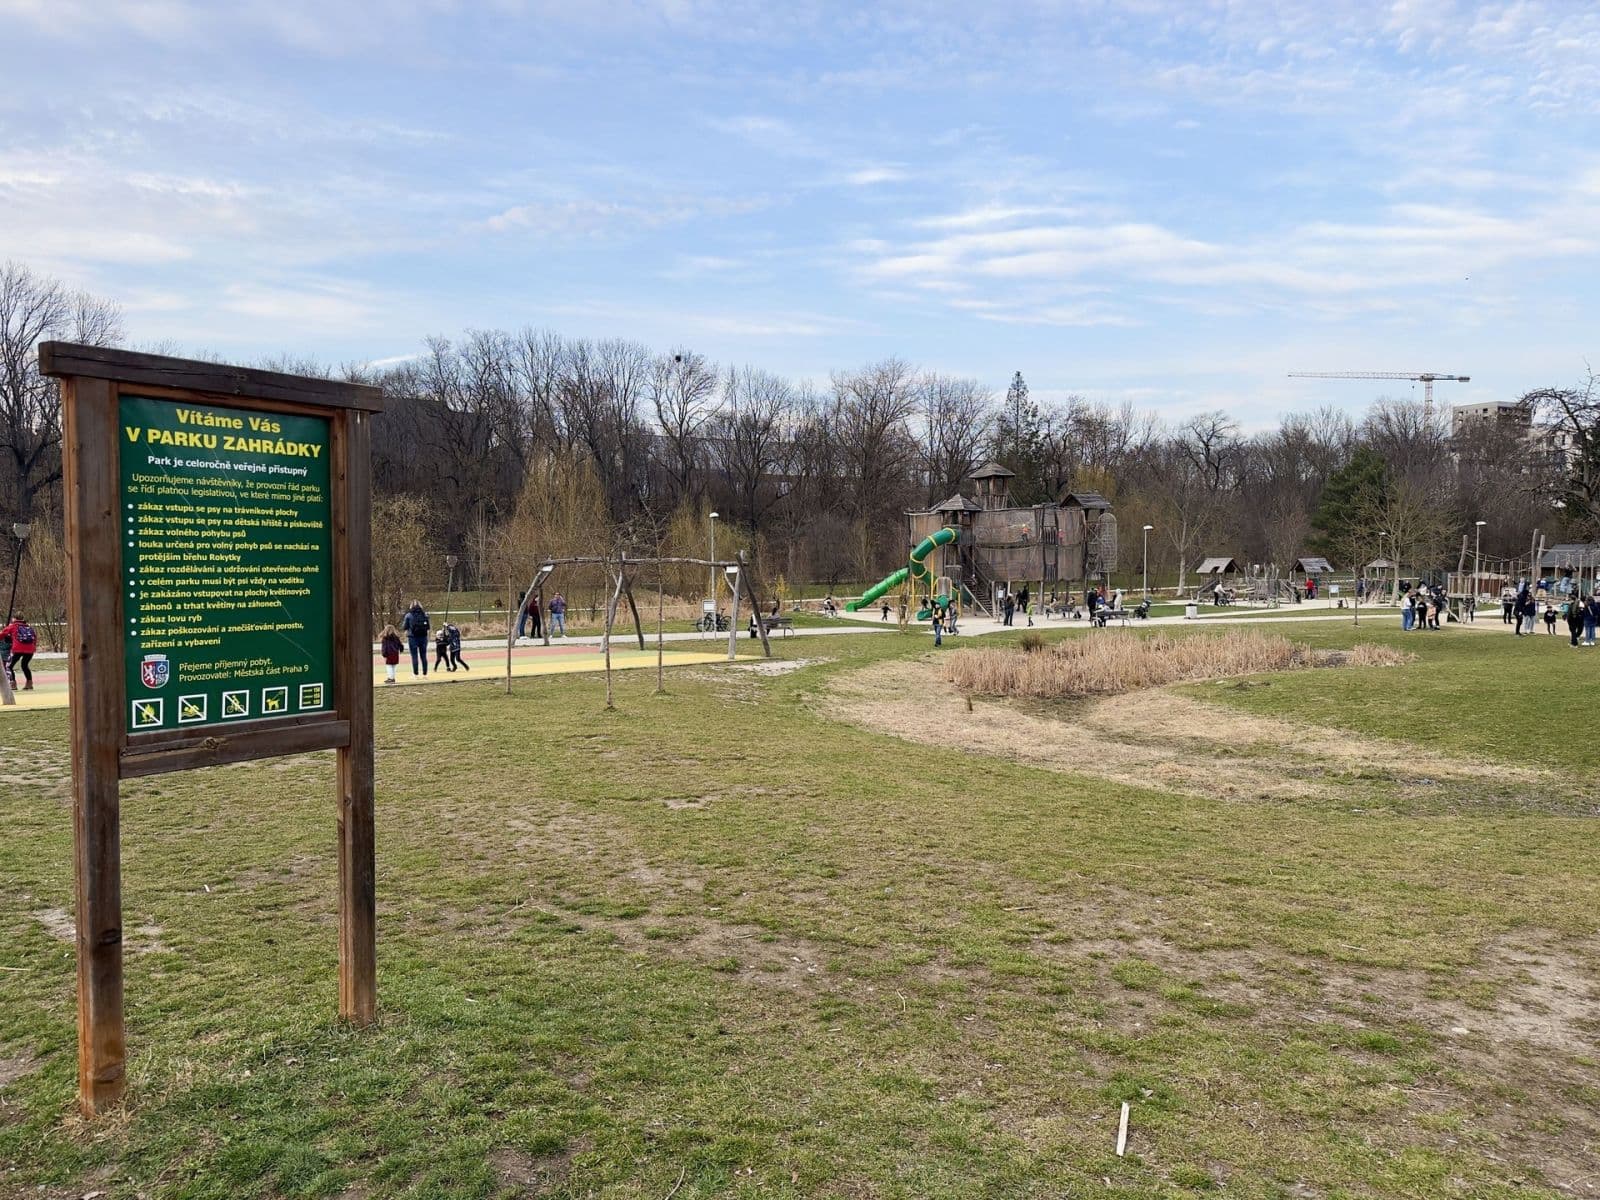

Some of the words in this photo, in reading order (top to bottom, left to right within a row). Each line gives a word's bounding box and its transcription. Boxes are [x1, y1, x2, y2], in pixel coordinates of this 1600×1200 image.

[176, 409, 243, 429] Vítáme
[248, 416, 281, 433] Vás
[126, 427, 140, 442] V
[148, 429, 217, 448] PARKU
[223, 436, 321, 458] ZAHRÁDKY
[148, 456, 171, 465] Park
[173, 457, 183, 467] je
[186, 460, 231, 469] celoročně
[233, 462, 267, 473] veřejně
[269, 464, 308, 477] přístupný
[132, 473, 193, 485] Upozorňujeme
[158, 486, 188, 495] platnou
[192, 488, 237, 498] legislativou,
[251, 491, 269, 499] které
[138, 502, 163, 510] zákaz
[165, 505, 194, 513] vstupu
[235, 507, 274, 515] trávníkové
[275, 508, 298, 517] plochy
[138, 515, 163, 523] zákaz
[165, 516, 194, 525] vstupu
[201, 530, 230, 538] pohybu
[233, 530, 246, 538] psů
[212, 542, 233, 550] volný
[235, 542, 258, 550] pohyb
[260, 542, 272, 551] psů
[139, 553, 181, 562] protějším
[210, 554, 241, 562] Rokytky
[223, 578, 235, 586] být
[250, 577, 267, 585] vždy
[140, 591, 149, 600] je
[193, 590, 232, 598] vstupovat
[244, 589, 268, 597] plochy
[140, 602, 172, 610] záhonů
[188, 615, 202, 623] ryb
[168, 625, 219, 636] poškozování
[141, 639, 175, 648] zařízení
[184, 637, 221, 647] vybavení
[179, 663, 212, 672] Přejeme
[215, 658, 247, 670] příjemný
[179, 672, 231, 682] Provozovatel:
[234, 669, 264, 677] Městská
[283, 665, 302, 673] Praha
